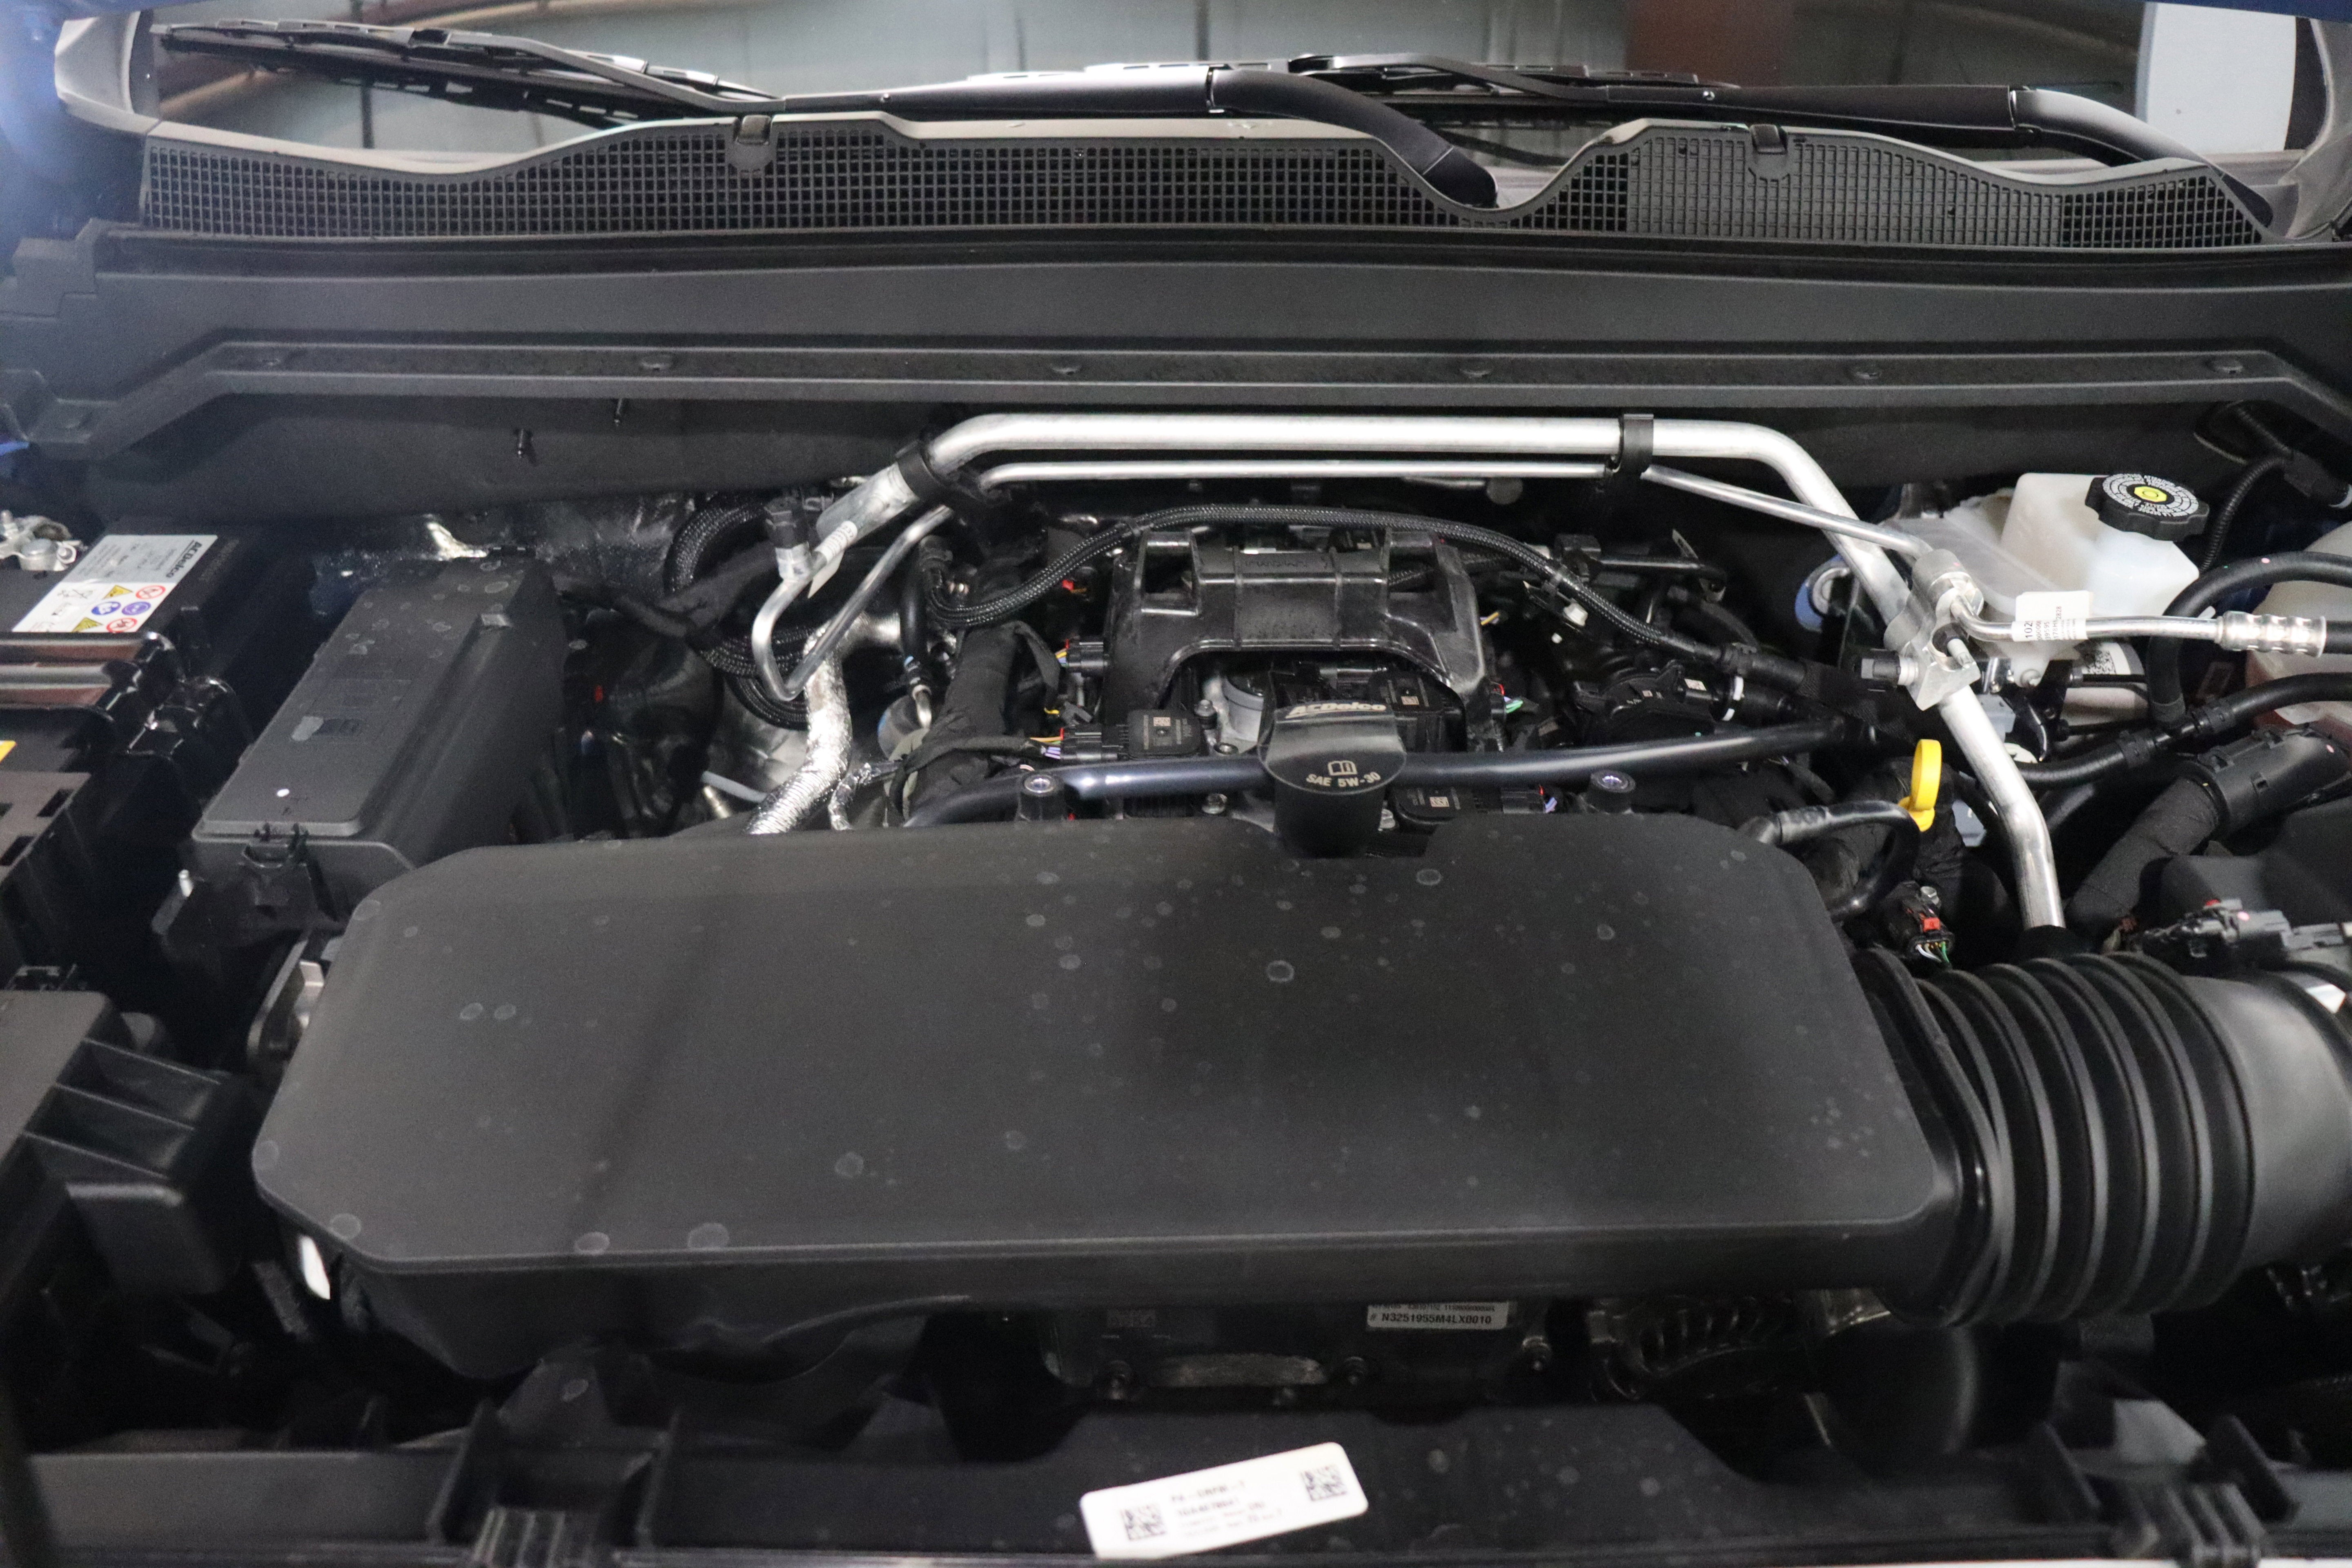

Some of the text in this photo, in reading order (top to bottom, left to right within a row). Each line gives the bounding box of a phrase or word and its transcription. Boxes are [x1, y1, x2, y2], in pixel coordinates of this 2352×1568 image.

[166, 541, 202, 578] ACDelco
[2024, 621, 2033, 639] 102
[1286, 702, 1386, 717] ACDelco
[1306, 772, 1381, 787] SAE 5W-30
